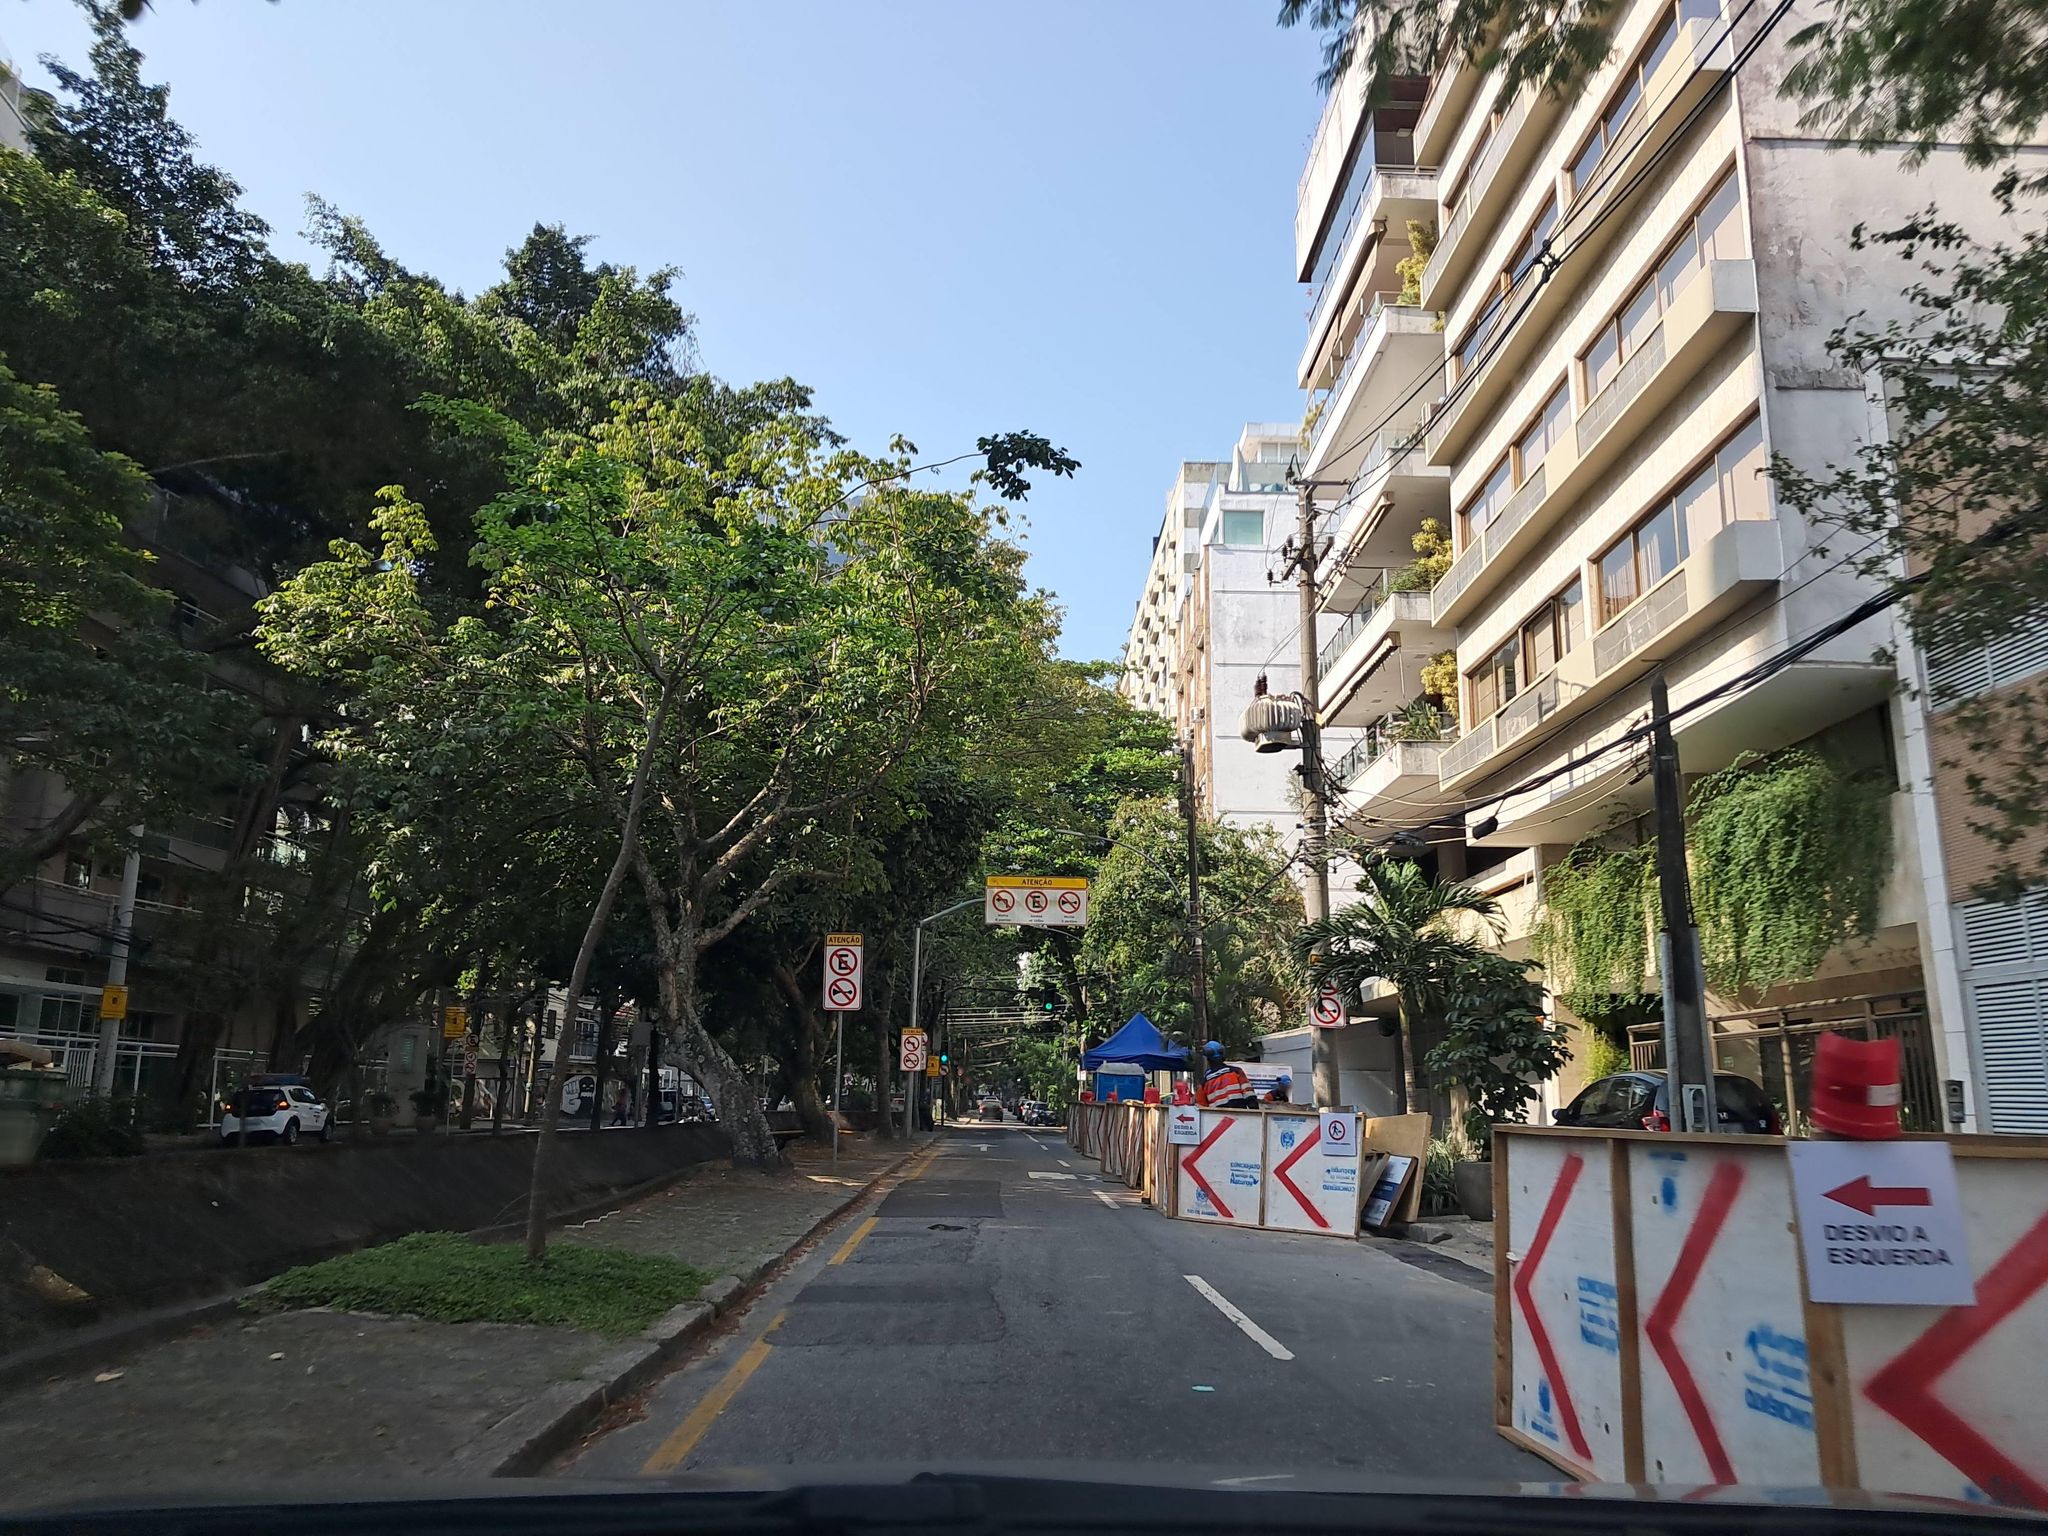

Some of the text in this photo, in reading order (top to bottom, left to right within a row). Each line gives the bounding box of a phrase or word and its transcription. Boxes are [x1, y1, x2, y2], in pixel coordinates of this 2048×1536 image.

[1022, 878, 1053, 886] ATENÇÃO
[828, 935, 860, 944] ATENÇÃO
[1823, 1224, 1931, 1243] DESVIO A
[1826, 1247, 1954, 1266] ESQUERDA
